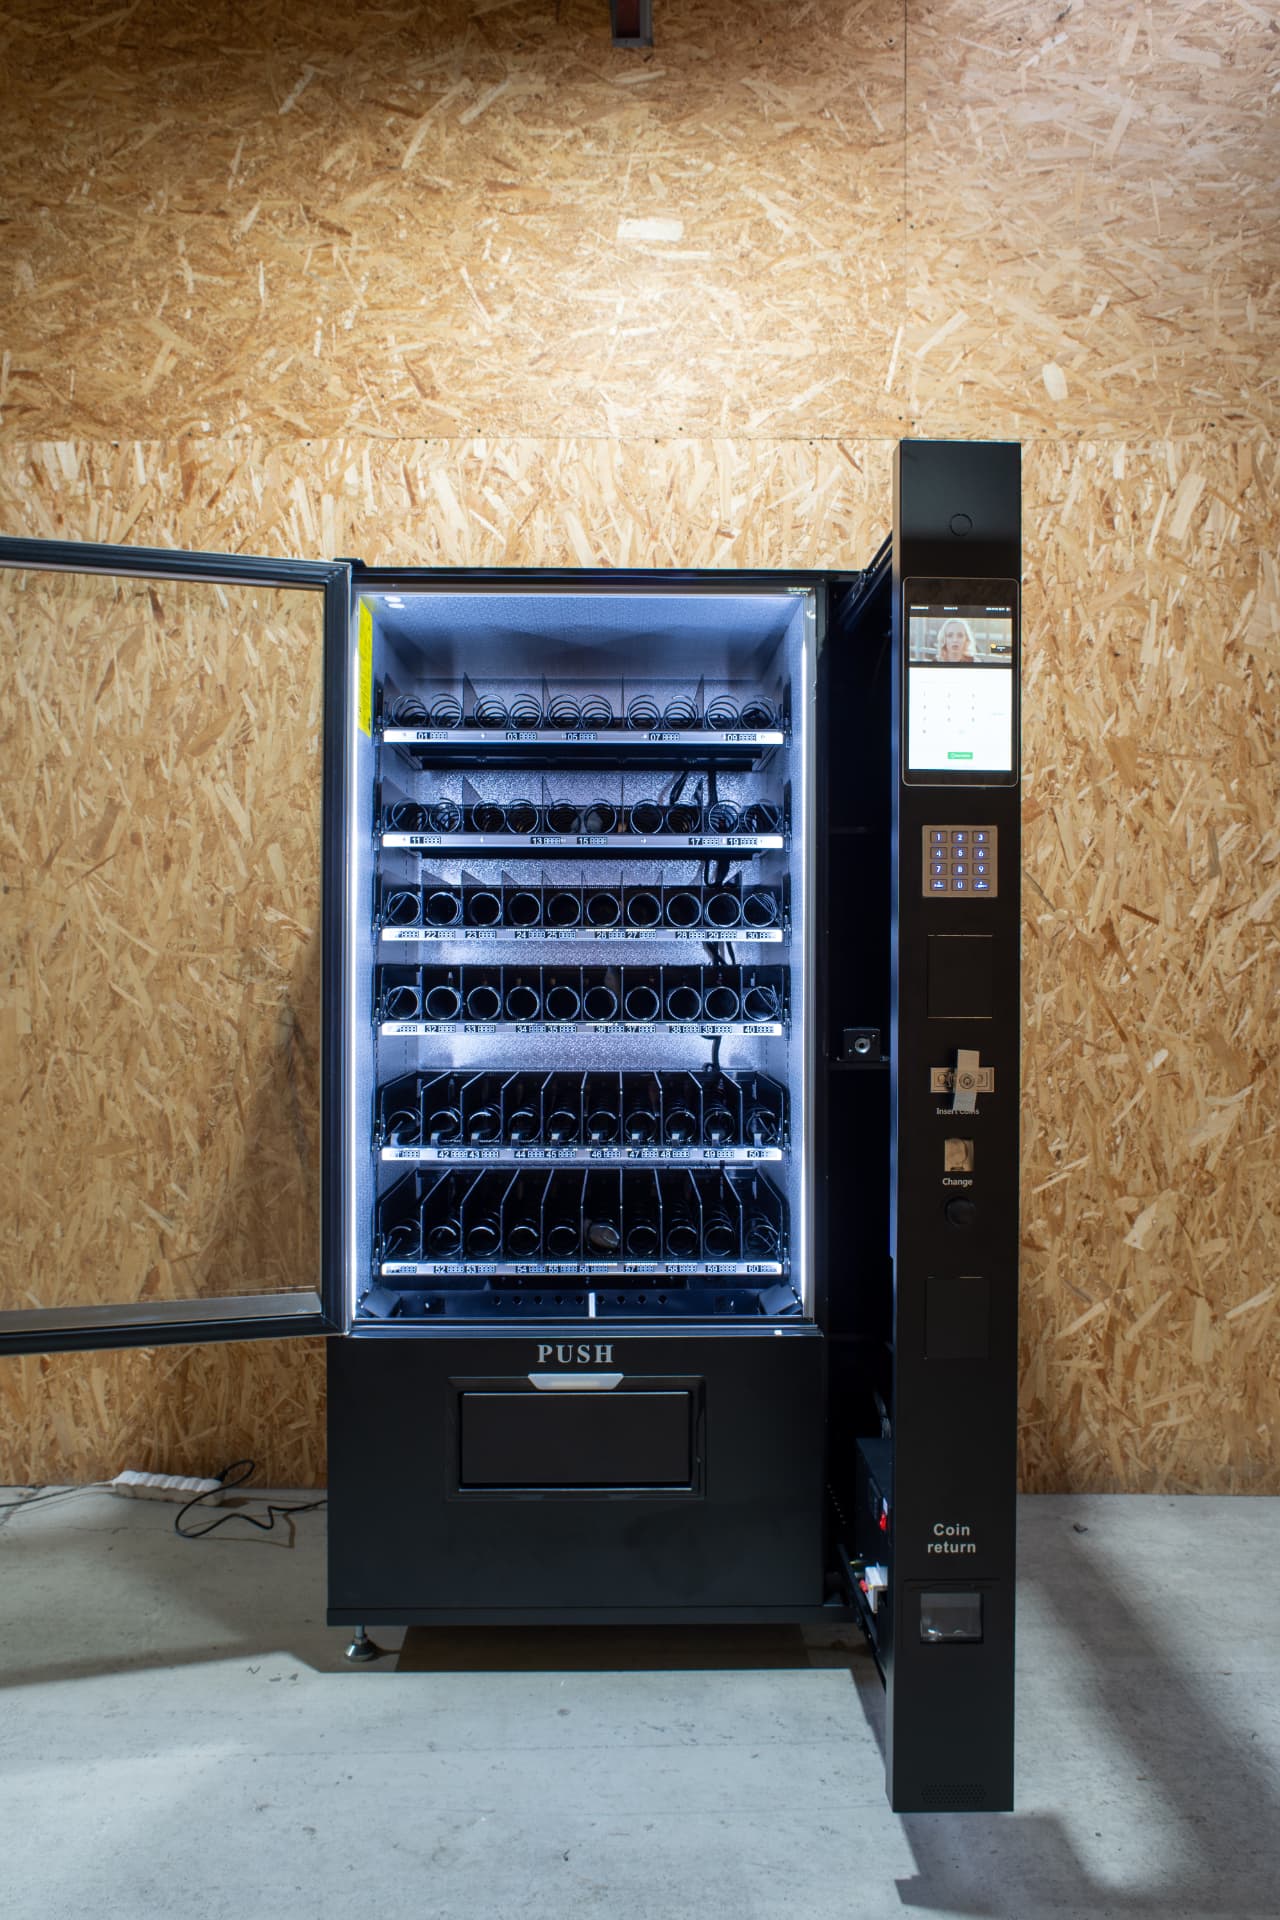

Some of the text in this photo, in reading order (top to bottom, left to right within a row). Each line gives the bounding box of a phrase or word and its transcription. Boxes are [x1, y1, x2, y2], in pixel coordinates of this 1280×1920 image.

[418, 732, 428, 740] 01
[507, 732, 518, 740] 03
[567, 732, 578, 740] 05
[425, 1025, 436, 1033] 32
[516, 1025, 527, 1033] 34
[626, 1025, 637, 1033] 37
[745, 1025, 755, 1033] 40
[942, 1178, 973, 1187] Change
[435, 1265, 446, 1273] 52
[536, 1344, 615, 1363] PUSH
[933, 1523, 971, 1536] Coin
[927, 1541, 977, 1553] return
